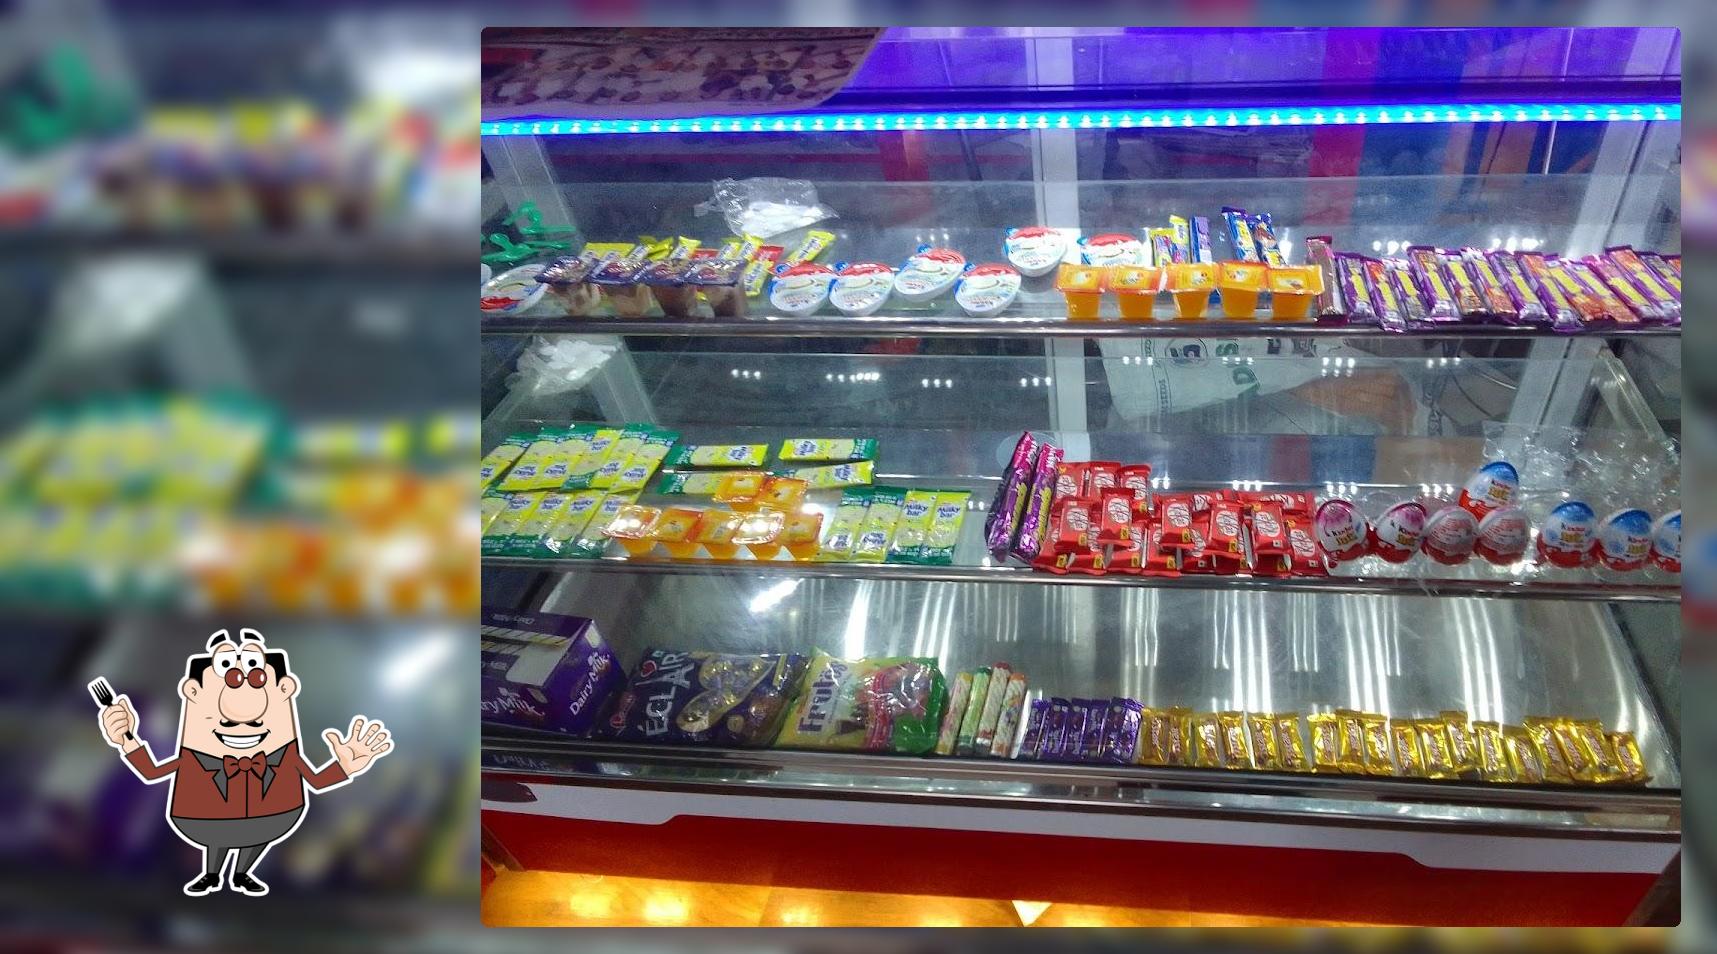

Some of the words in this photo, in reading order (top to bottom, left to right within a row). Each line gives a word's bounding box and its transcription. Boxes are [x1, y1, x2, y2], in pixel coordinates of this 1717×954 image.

[903, 502, 929, 513] Milky
[936, 504, 961, 514] Milky
[569, 682, 593, 716] Dairy
[589, 652, 610, 683] Milk
[498, 690, 543, 717] Milk
